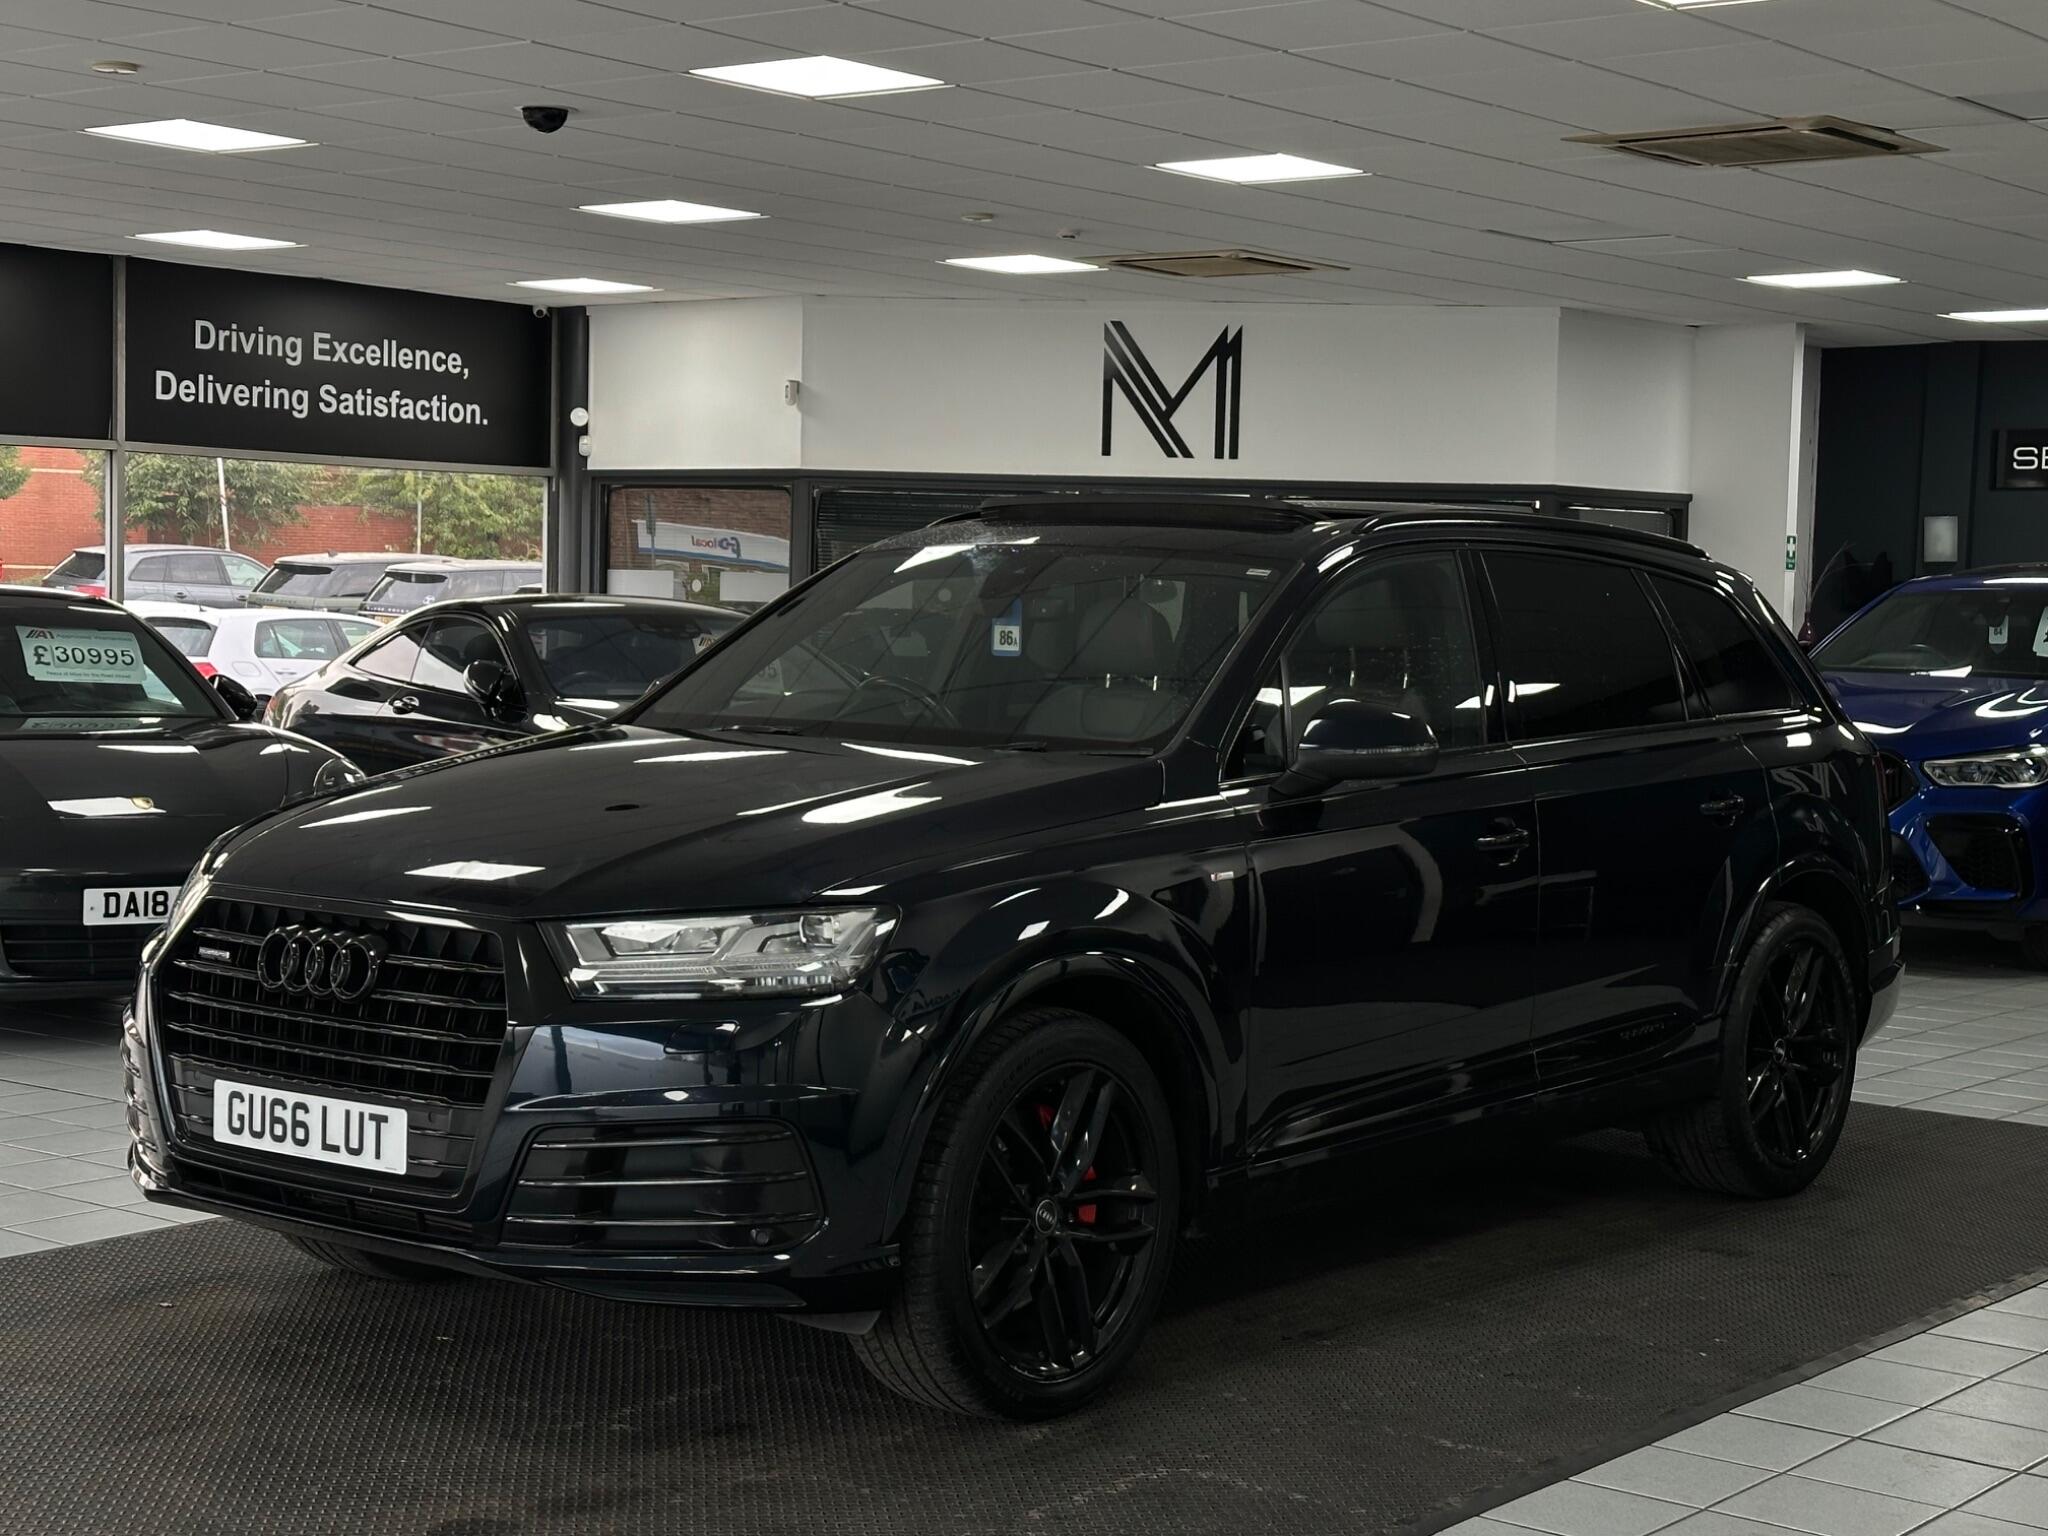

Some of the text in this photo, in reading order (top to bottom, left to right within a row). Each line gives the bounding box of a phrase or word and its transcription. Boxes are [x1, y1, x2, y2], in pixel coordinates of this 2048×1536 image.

[194, 319, 469, 379] Driving Excellence,
[155, 370, 489, 425] Delivering Satisfaction.
[2013, 446, 2048, 470] S
[103, 890, 169, 918] DA18
[227, 1090, 389, 1160] GU66 LUT
